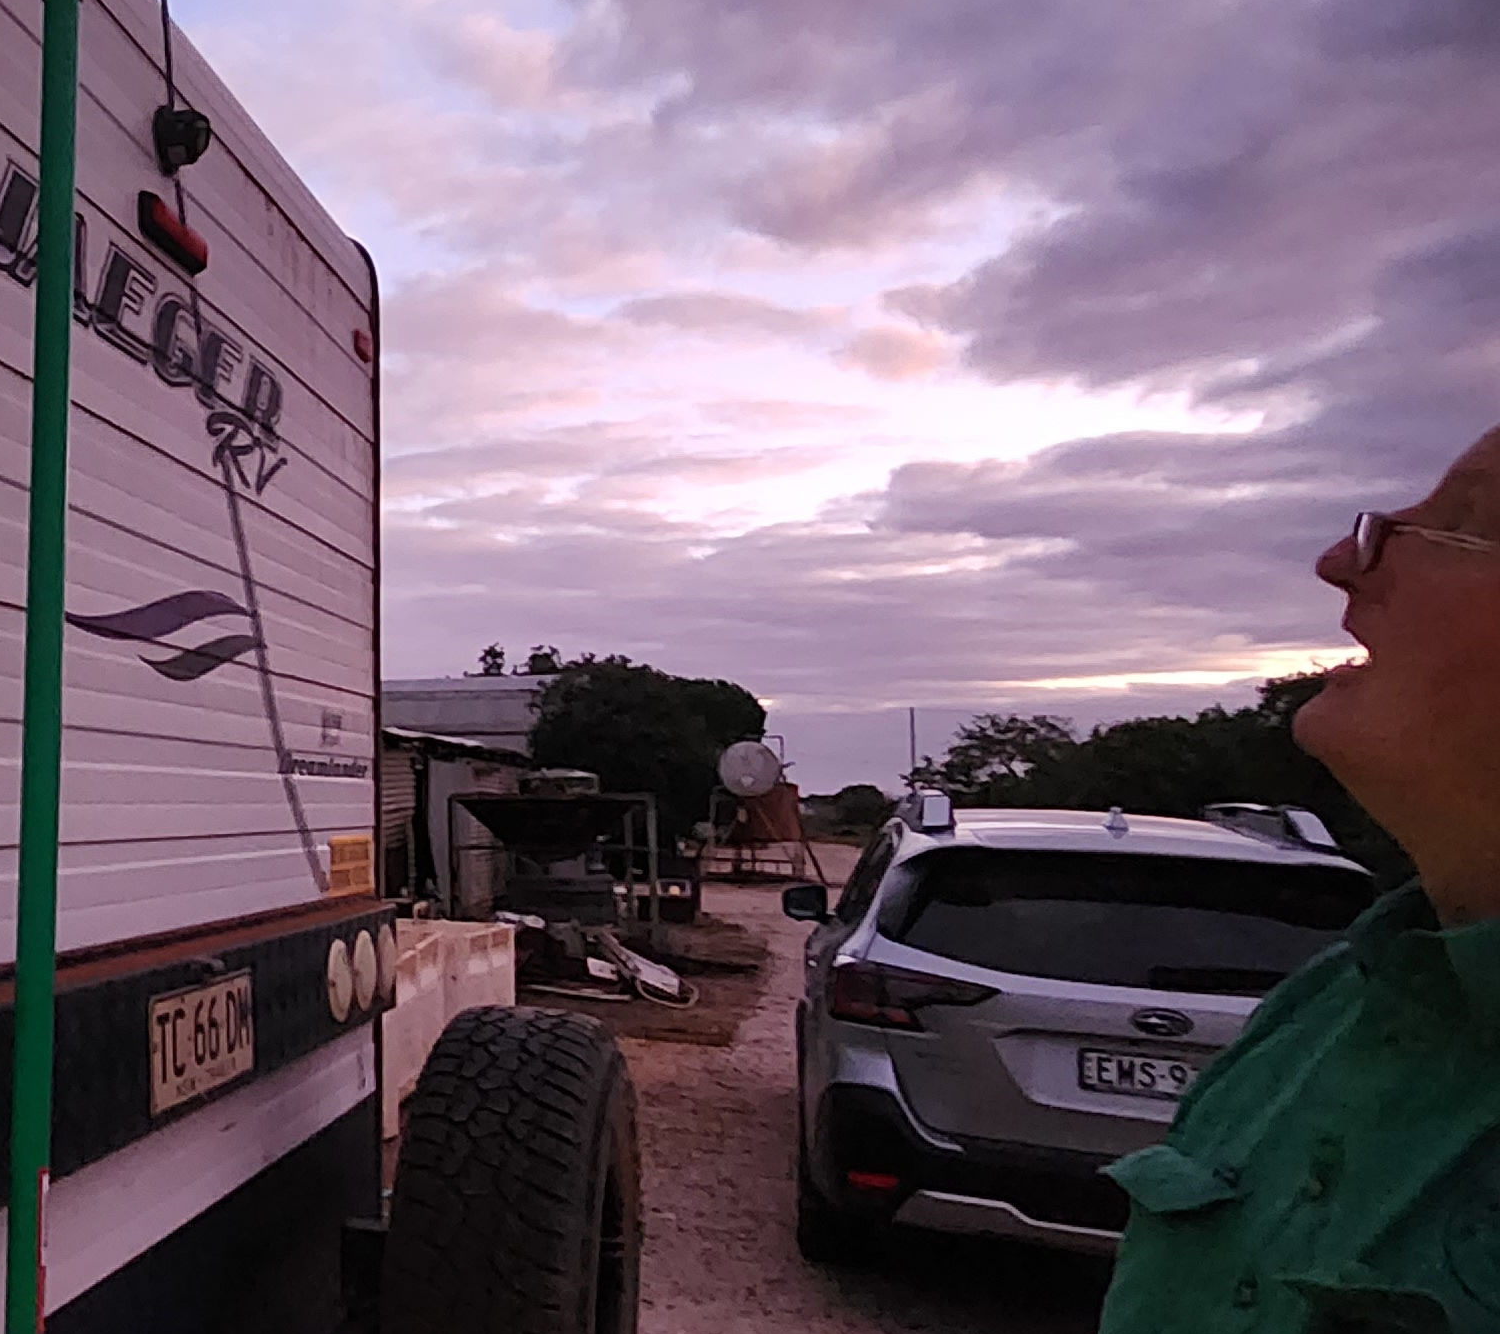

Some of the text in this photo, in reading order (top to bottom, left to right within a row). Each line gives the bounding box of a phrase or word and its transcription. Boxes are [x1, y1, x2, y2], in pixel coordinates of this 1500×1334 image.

[207, 411, 288, 495] RV
[156, 1007, 186, 1084] TC
[194, 996, 220, 1066] 66
